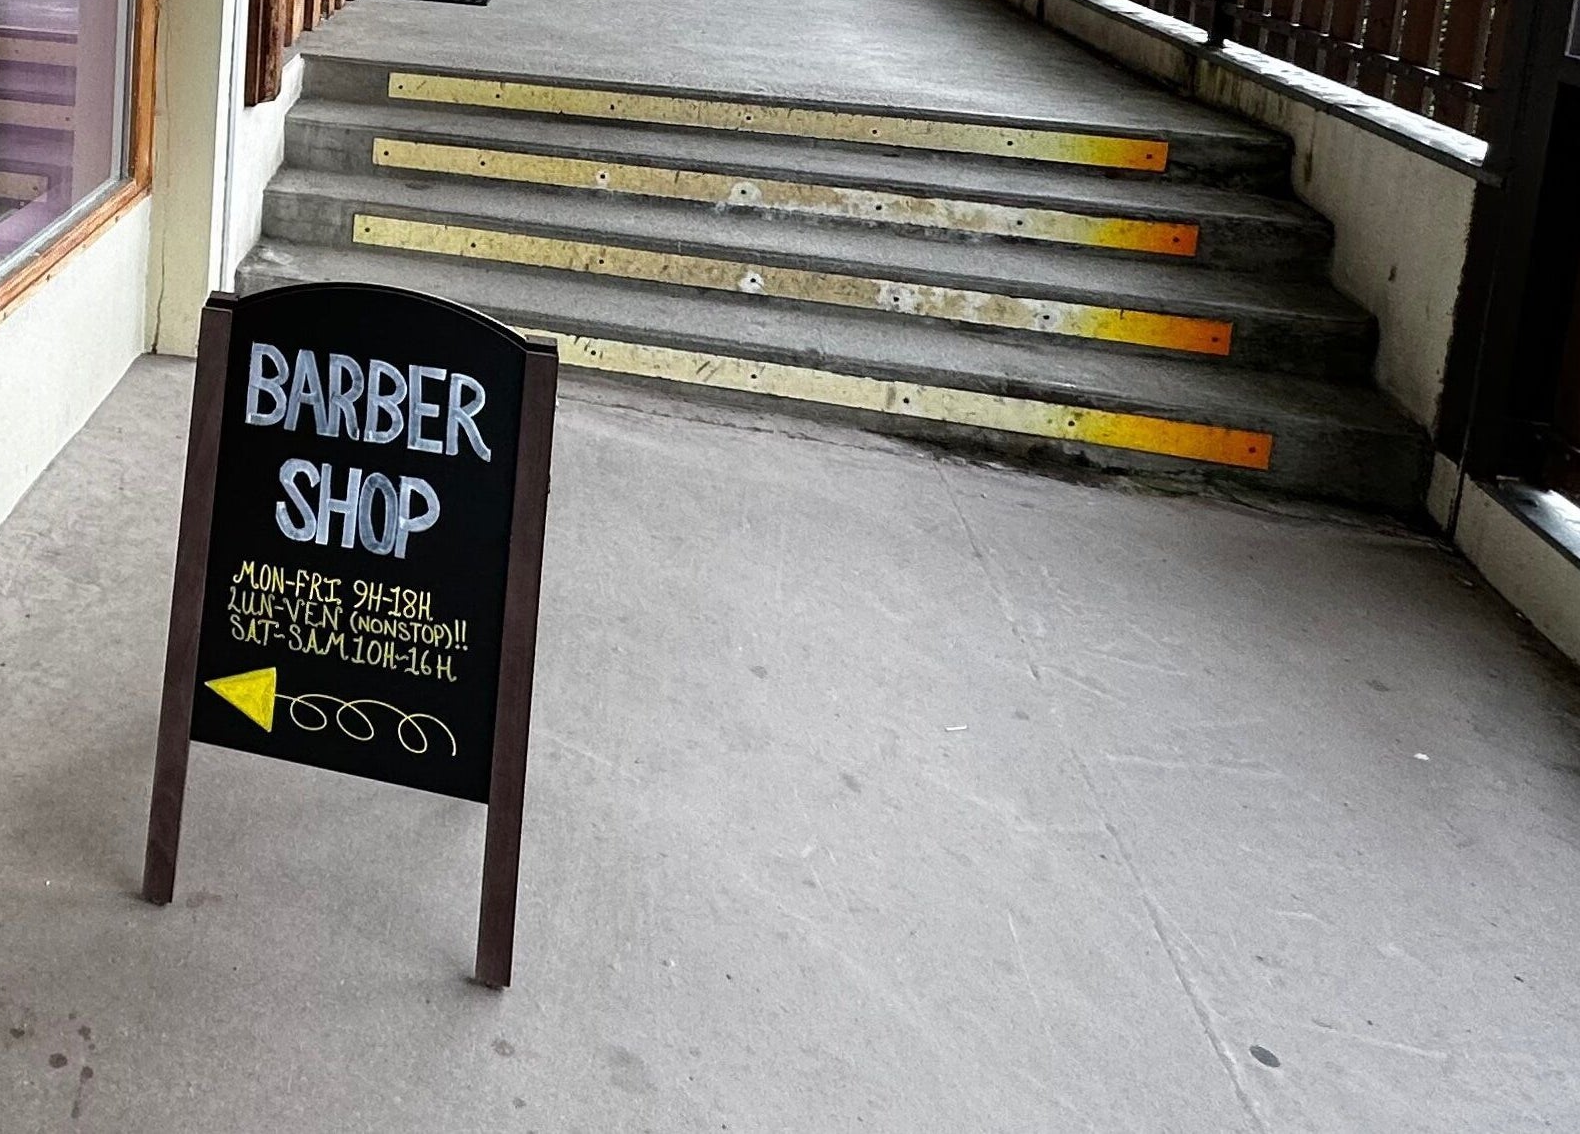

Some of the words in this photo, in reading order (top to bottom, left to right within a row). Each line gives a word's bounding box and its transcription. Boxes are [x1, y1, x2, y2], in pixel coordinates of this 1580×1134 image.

[245, 342, 491, 462] BARBER
[275, 458, 440, 559] SHOP
[228, 586, 343, 630] LUN-VEN
[350, 602, 469, 651] (NONSTOP)!!
[233, 561, 342, 605] MON-FRI
[353, 579, 432, 622] 9H-18H
[230, 615, 349, 661] SAT-SAM
